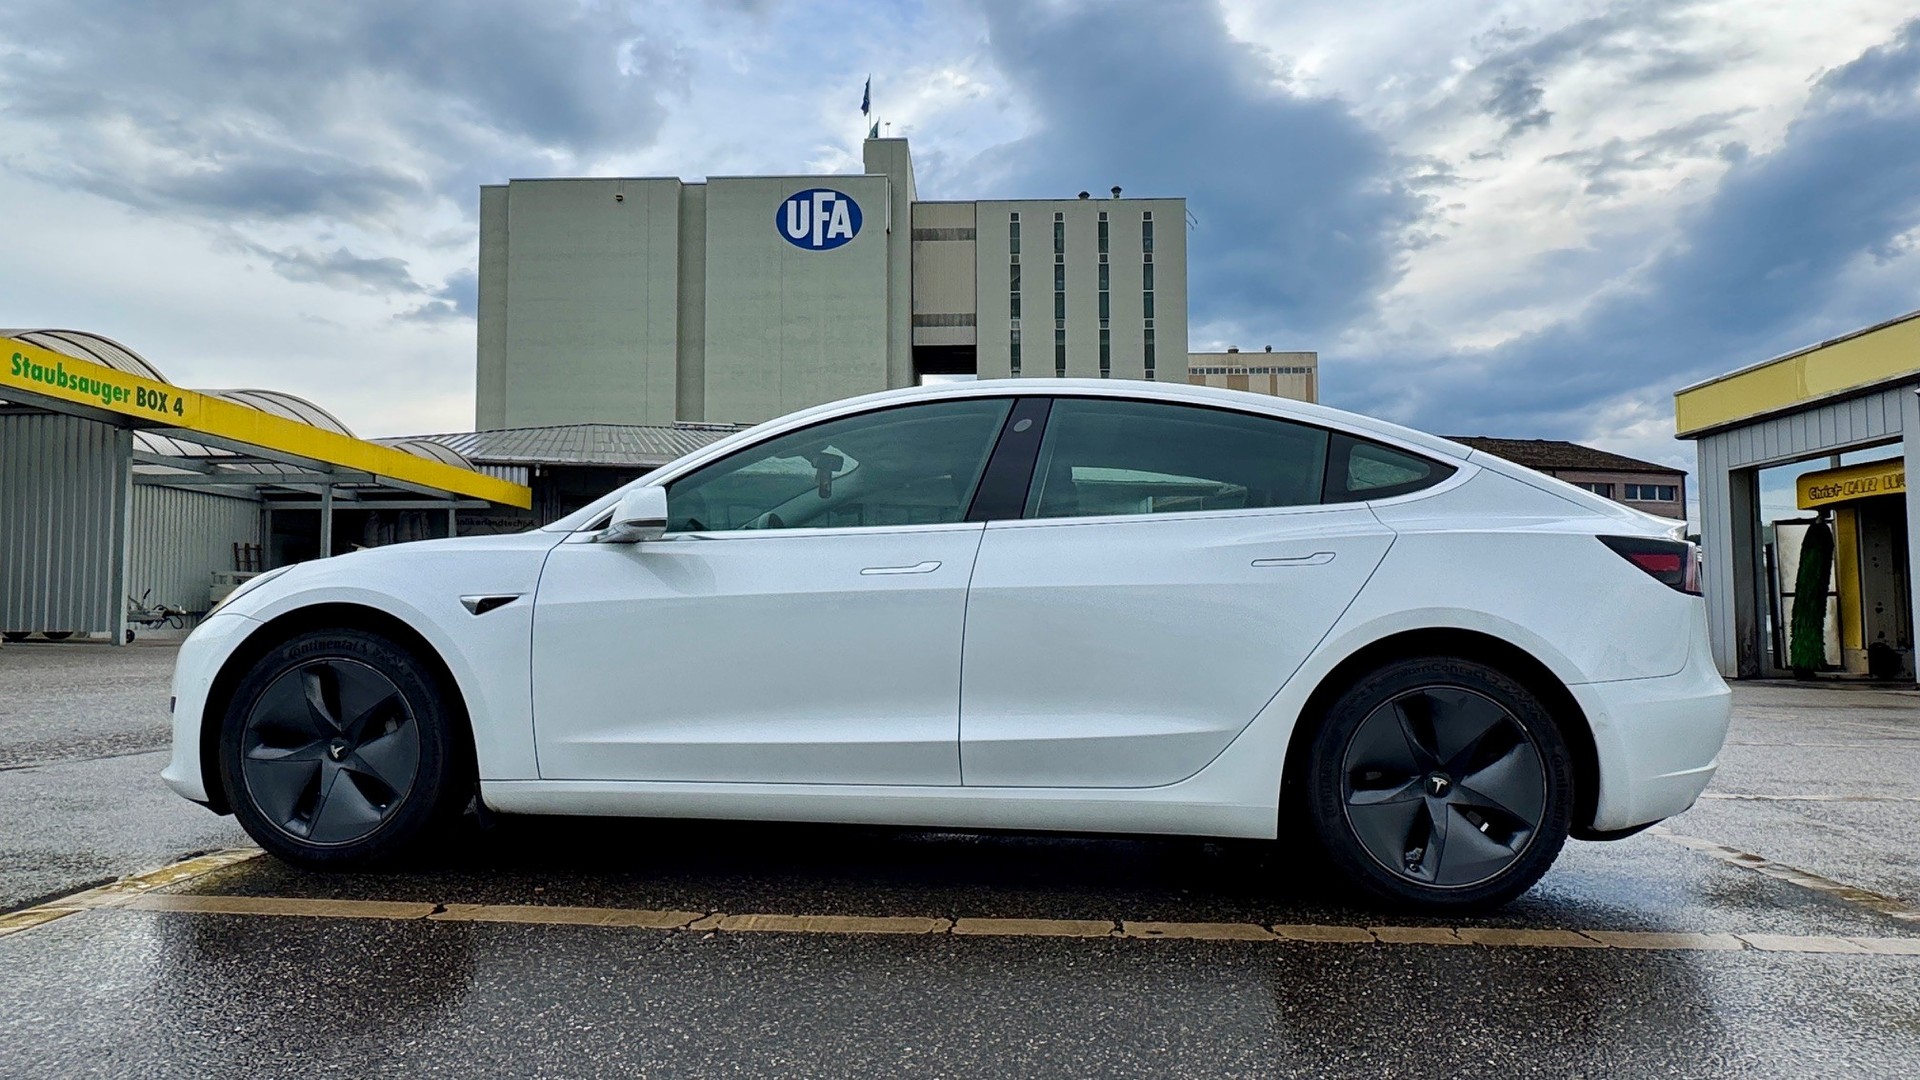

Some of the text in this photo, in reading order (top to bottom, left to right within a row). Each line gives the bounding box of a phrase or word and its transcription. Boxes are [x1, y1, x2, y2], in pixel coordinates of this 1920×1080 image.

[787, 192, 853, 247] UFA
[11, 352, 184, 417] Staubsauger BOX 4
[1808, 485, 1842, 499] Christ
[1844, 478, 1877, 495] CAR
[288, 638, 359, 659] Continental
